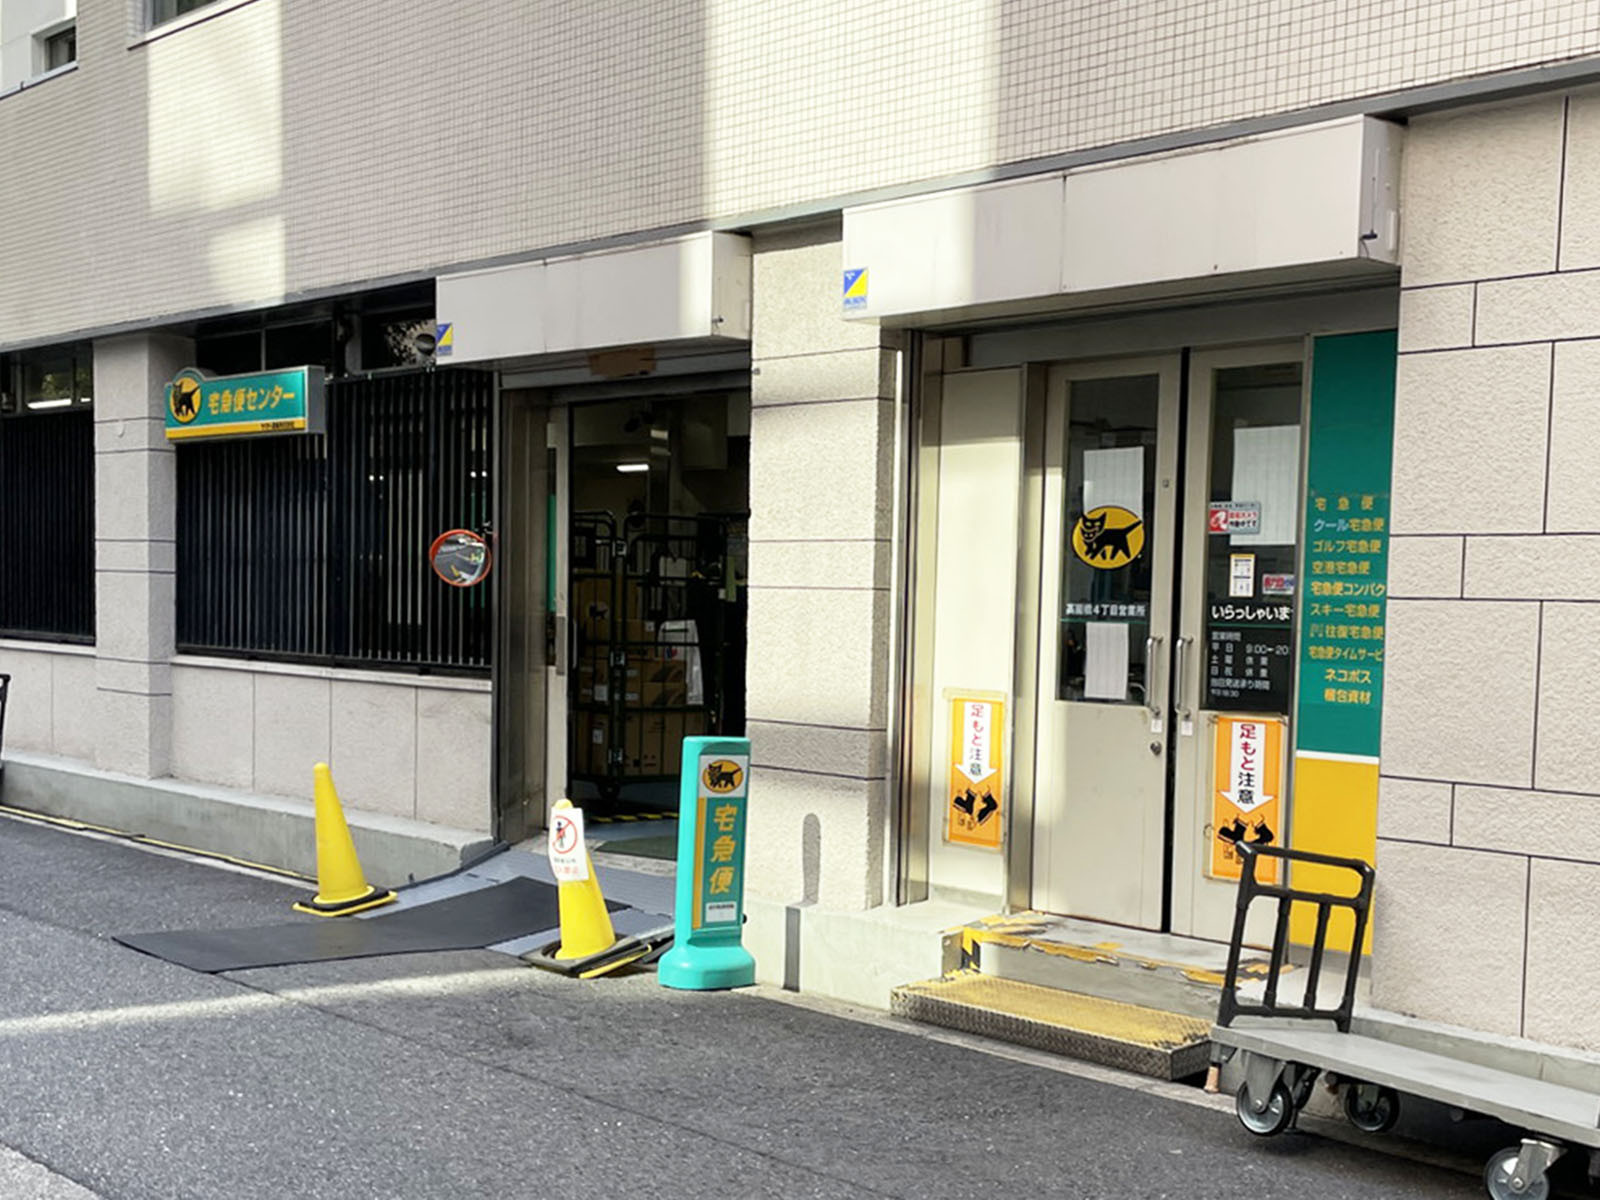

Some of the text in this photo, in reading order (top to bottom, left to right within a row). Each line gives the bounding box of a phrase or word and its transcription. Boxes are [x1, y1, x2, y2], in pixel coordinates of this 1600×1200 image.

[208, 385, 295, 415] 宅急便センター
[1314, 518, 1384, 532] クール宅急便
[1313, 540, 1381, 554] ゴルフ宅急便
[1312, 561, 1370, 575] 空港宅急便
[1212, 604, 1294, 620] いらっしゃいま
[1310, 603, 1380, 618] スキー宅急便
[1324, 688, 1371, 704] 梱包資材
[969, 703, 984, 776] 足もと注意
[1237, 723, 1257, 805] 足もと注意
[709, 803, 738, 895] 宅急便
